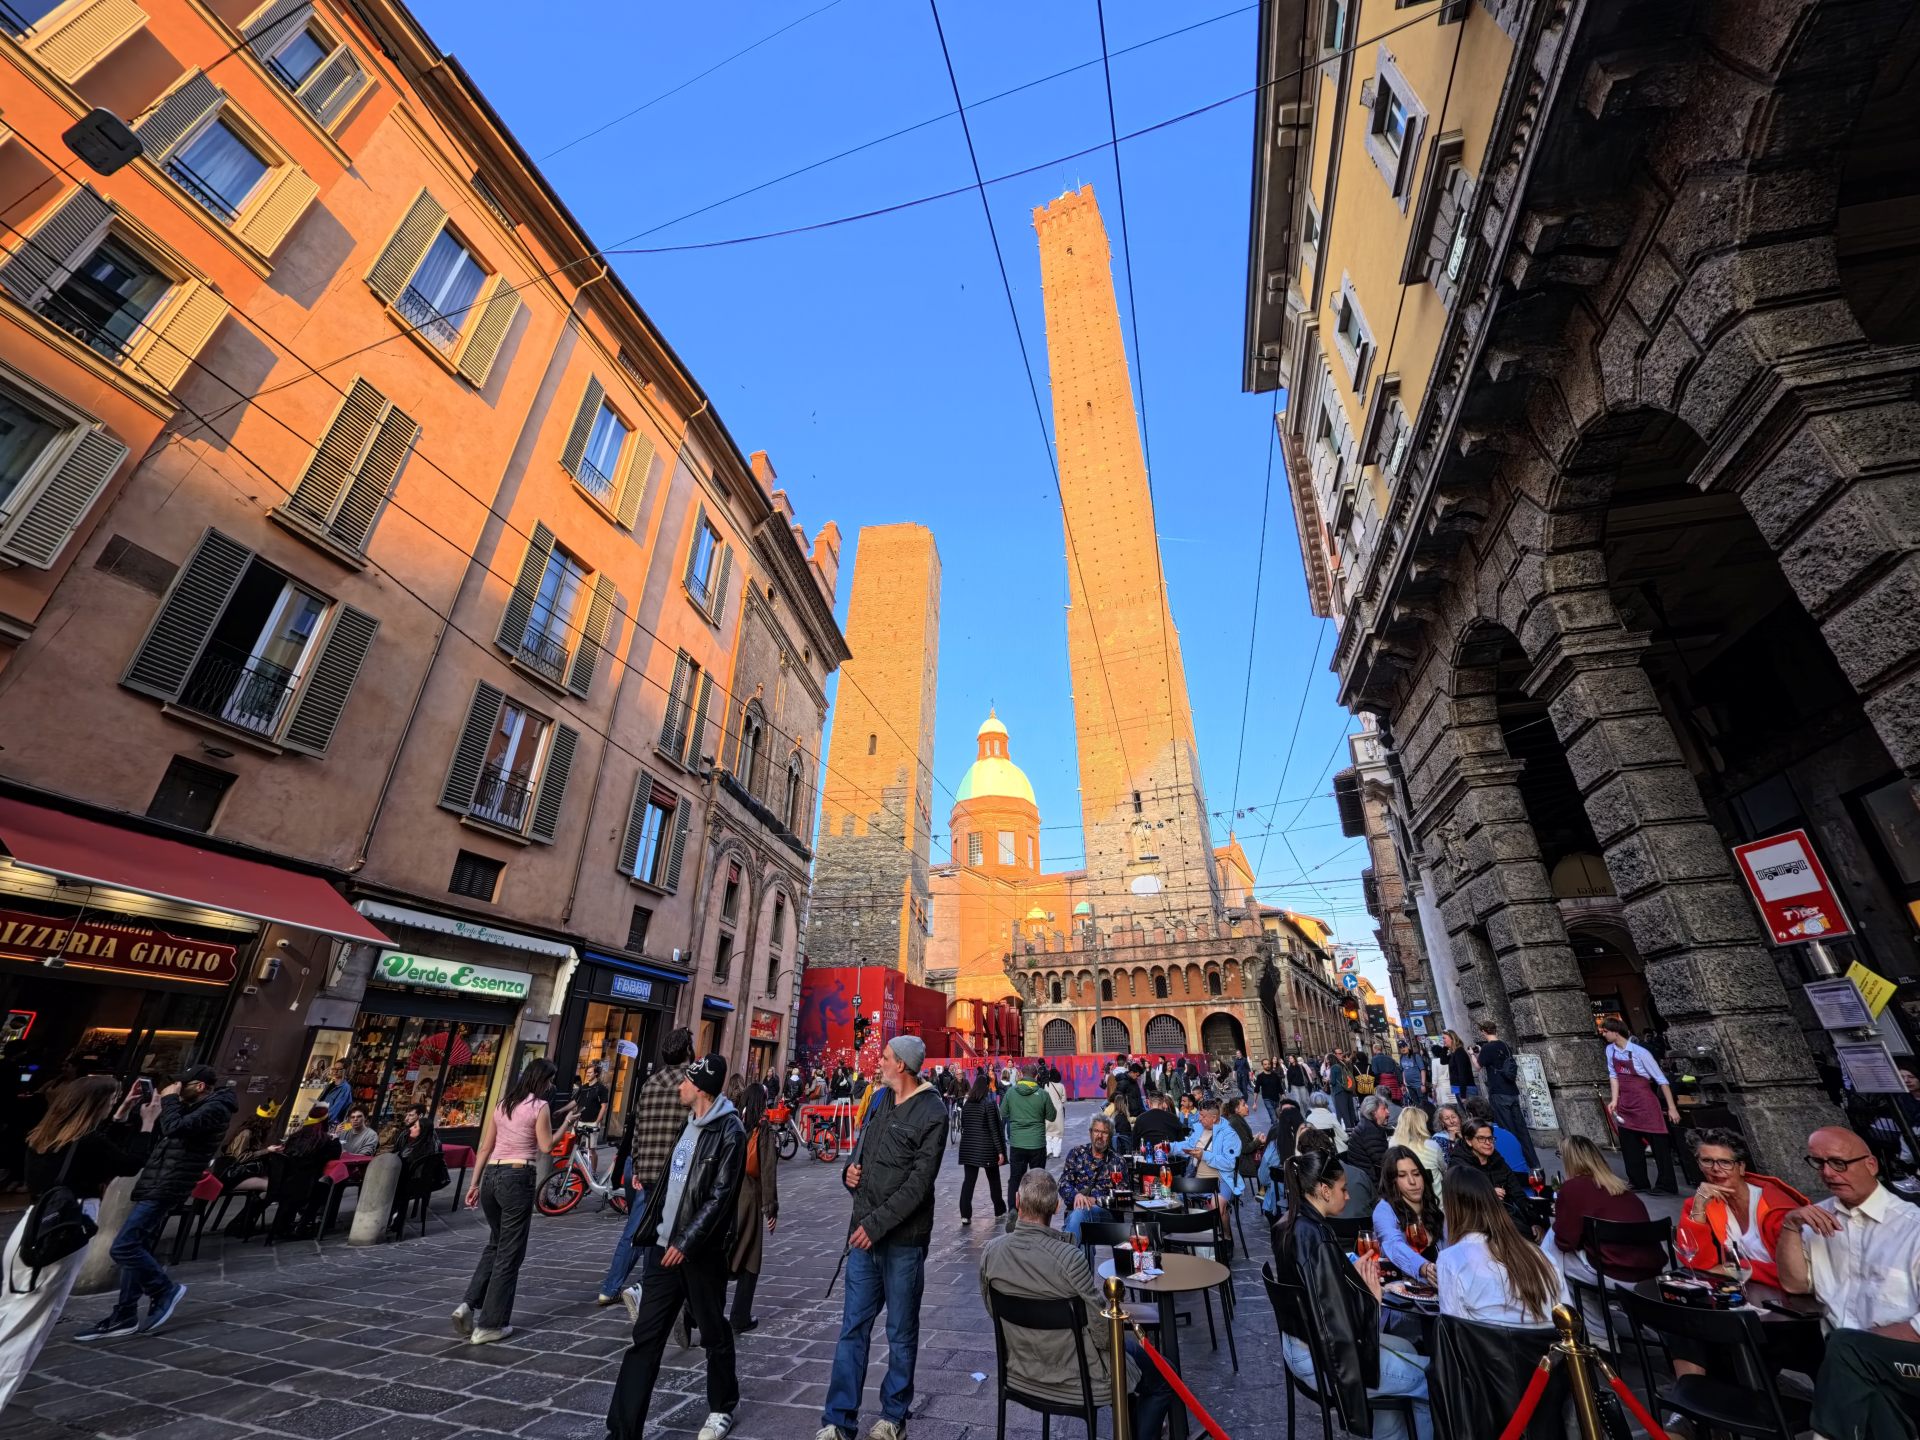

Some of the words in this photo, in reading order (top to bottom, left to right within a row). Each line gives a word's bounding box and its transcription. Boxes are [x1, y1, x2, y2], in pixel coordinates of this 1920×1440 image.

[0, 920, 118, 958] IZZERIA
[129, 941, 221, 972] GINGIO
[455, 922, 478, 935] Verde
[478, 927, 505, 941] Essenza
[382, 955, 448, 984] Verde
[450, 966, 525, 994] Essenza
